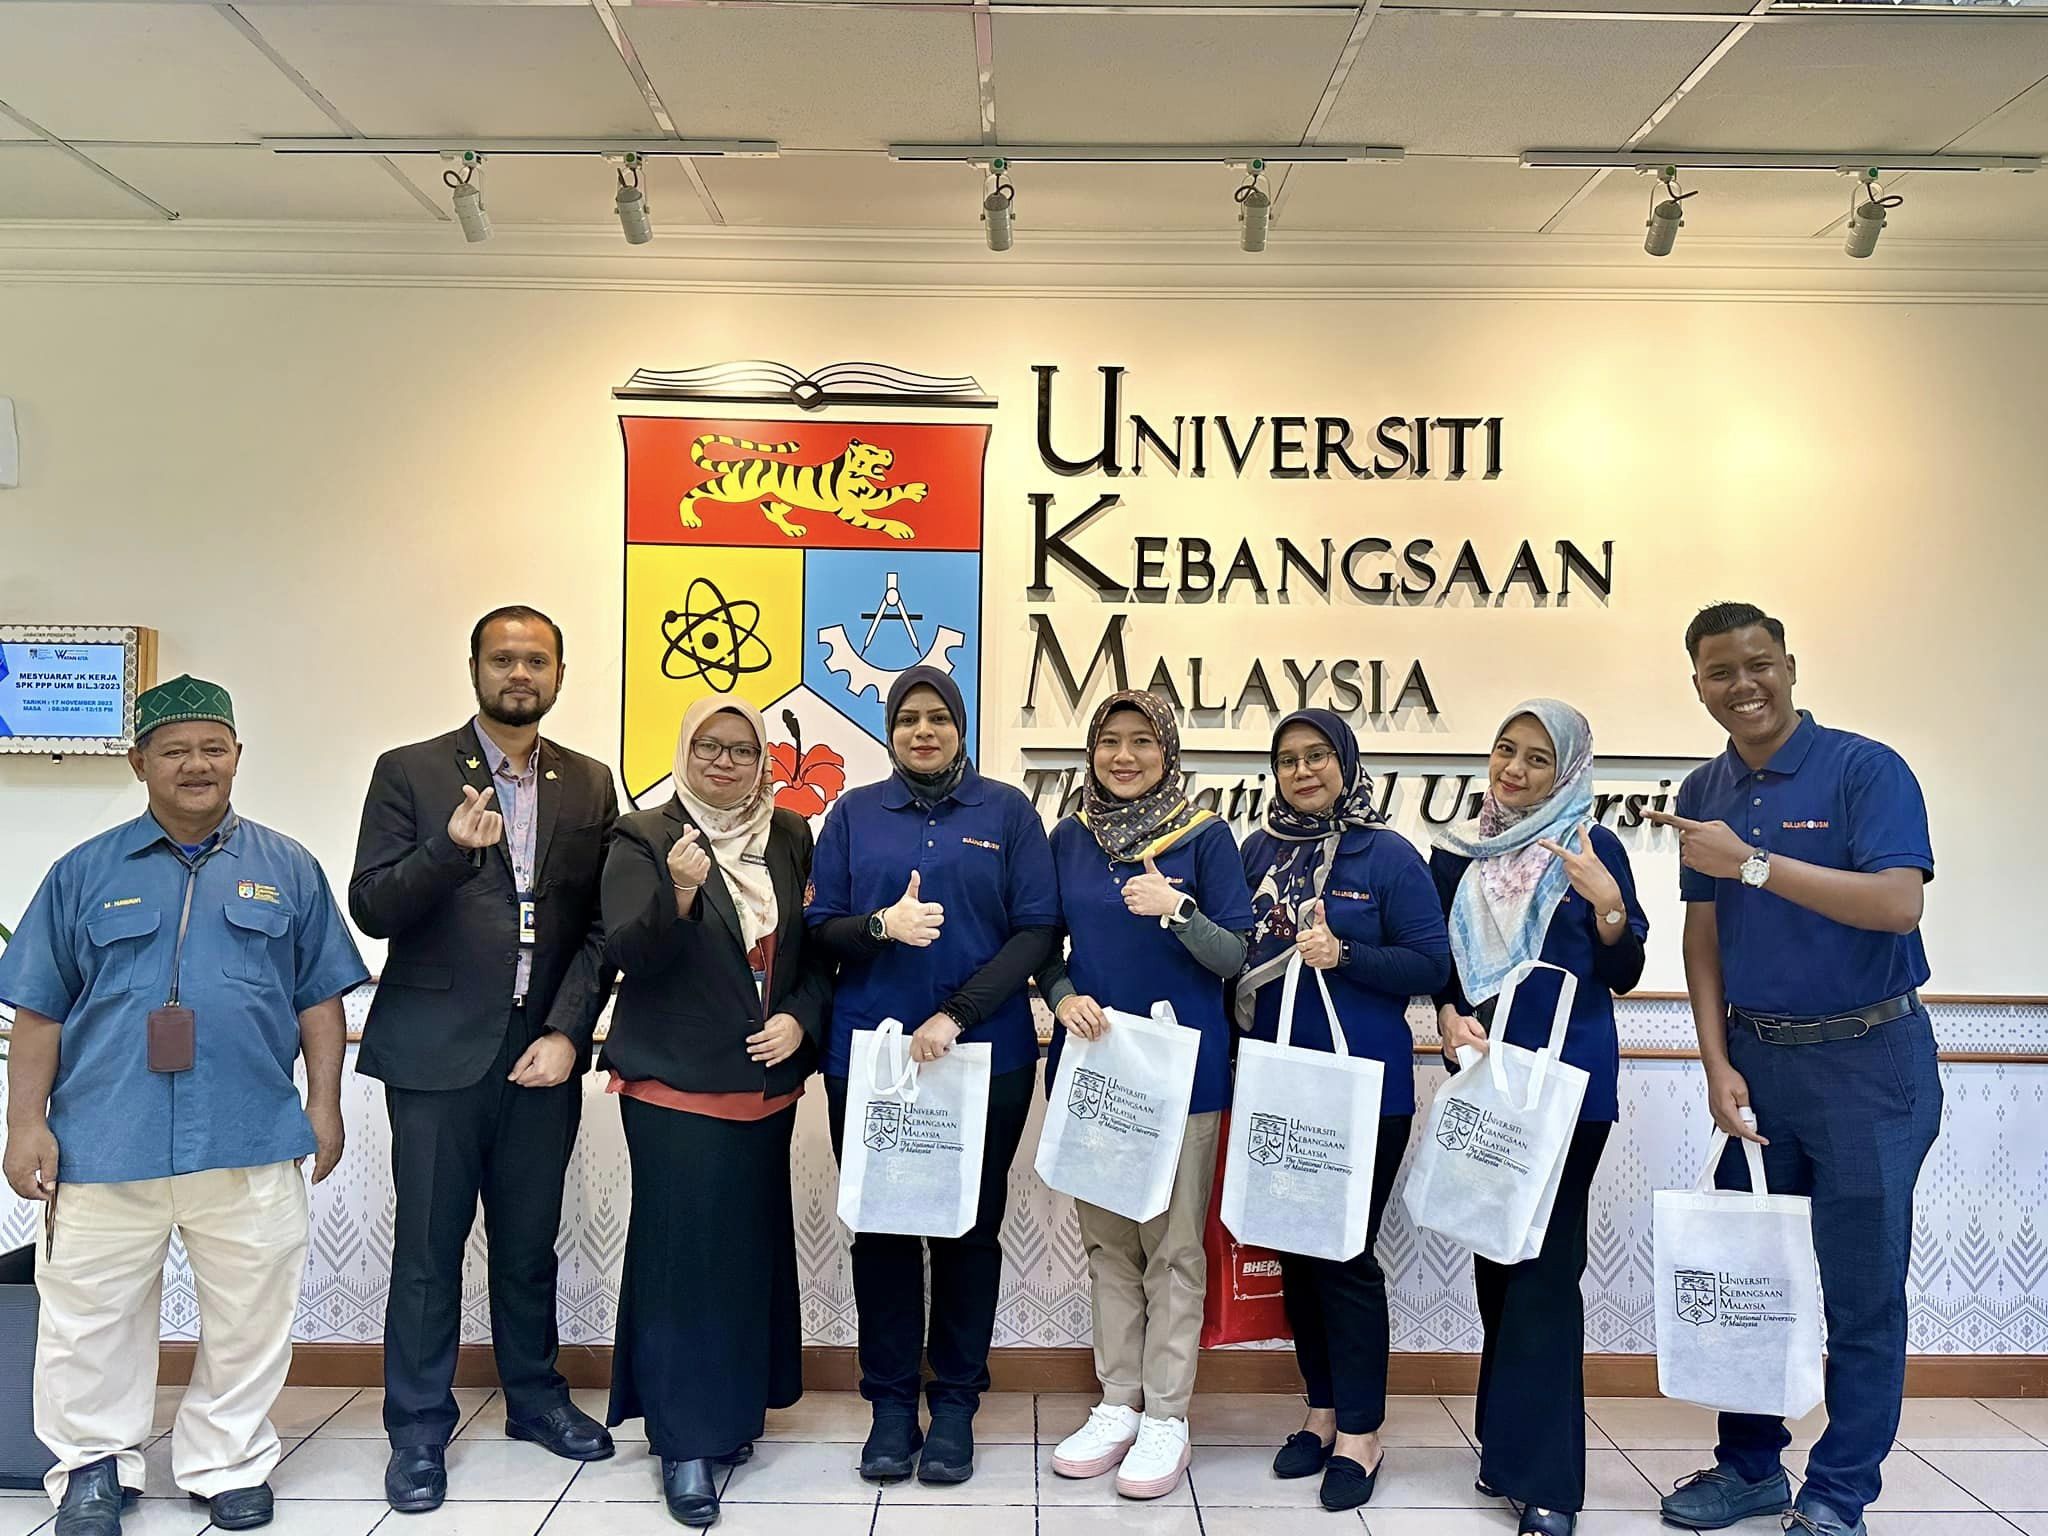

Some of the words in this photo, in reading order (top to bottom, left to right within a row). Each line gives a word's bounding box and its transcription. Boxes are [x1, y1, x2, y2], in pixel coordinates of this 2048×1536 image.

[1030, 364, 1505, 480] UNIVERSITI
[1026, 493, 1616, 604] KEBANGSAAN
[1025, 613, 1441, 720] MALAYSIA
[20, 672, 72, 680] MESYUARAT
[1023, 768, 1084, 819] Th
[1107, 1077, 1147, 1100] UNIVERSITI
[904, 1102, 948, 1117] UNIVERSITI
[1102, 1100, 1136, 1121] MALAYSIA
[1105, 1089, 1154, 1114] KEBANGSAAN
[902, 1115, 957, 1128] KEBANGSAAN
[1290, 1118, 1336, 1136] UNIVERSITI
[1482, 1110, 1522, 1134] UNIVERSITI
[902, 1126, 940, 1138] MALAYSIA
[1288, 1130, 1345, 1150] KEBANGSAAN
[1477, 1121, 1528, 1150] KEBANGSAAN
[1286, 1142, 1328, 1159] MALAYSIA
[1472, 1132, 1511, 1155] MALAYSIA
[1291, 1164, 1318, 1174] Malaysia
[1298, 1159, 1321, 1168] National
[1323, 1162, 1352, 1176] University
[1719, 1272, 1770, 1285] UNIVERSITI
[1719, 1285, 1782, 1297] KEBANGSAAN
[1720, 1298, 1766, 1310] MALAYSIA
[1763, 1314, 1797, 1323] University
